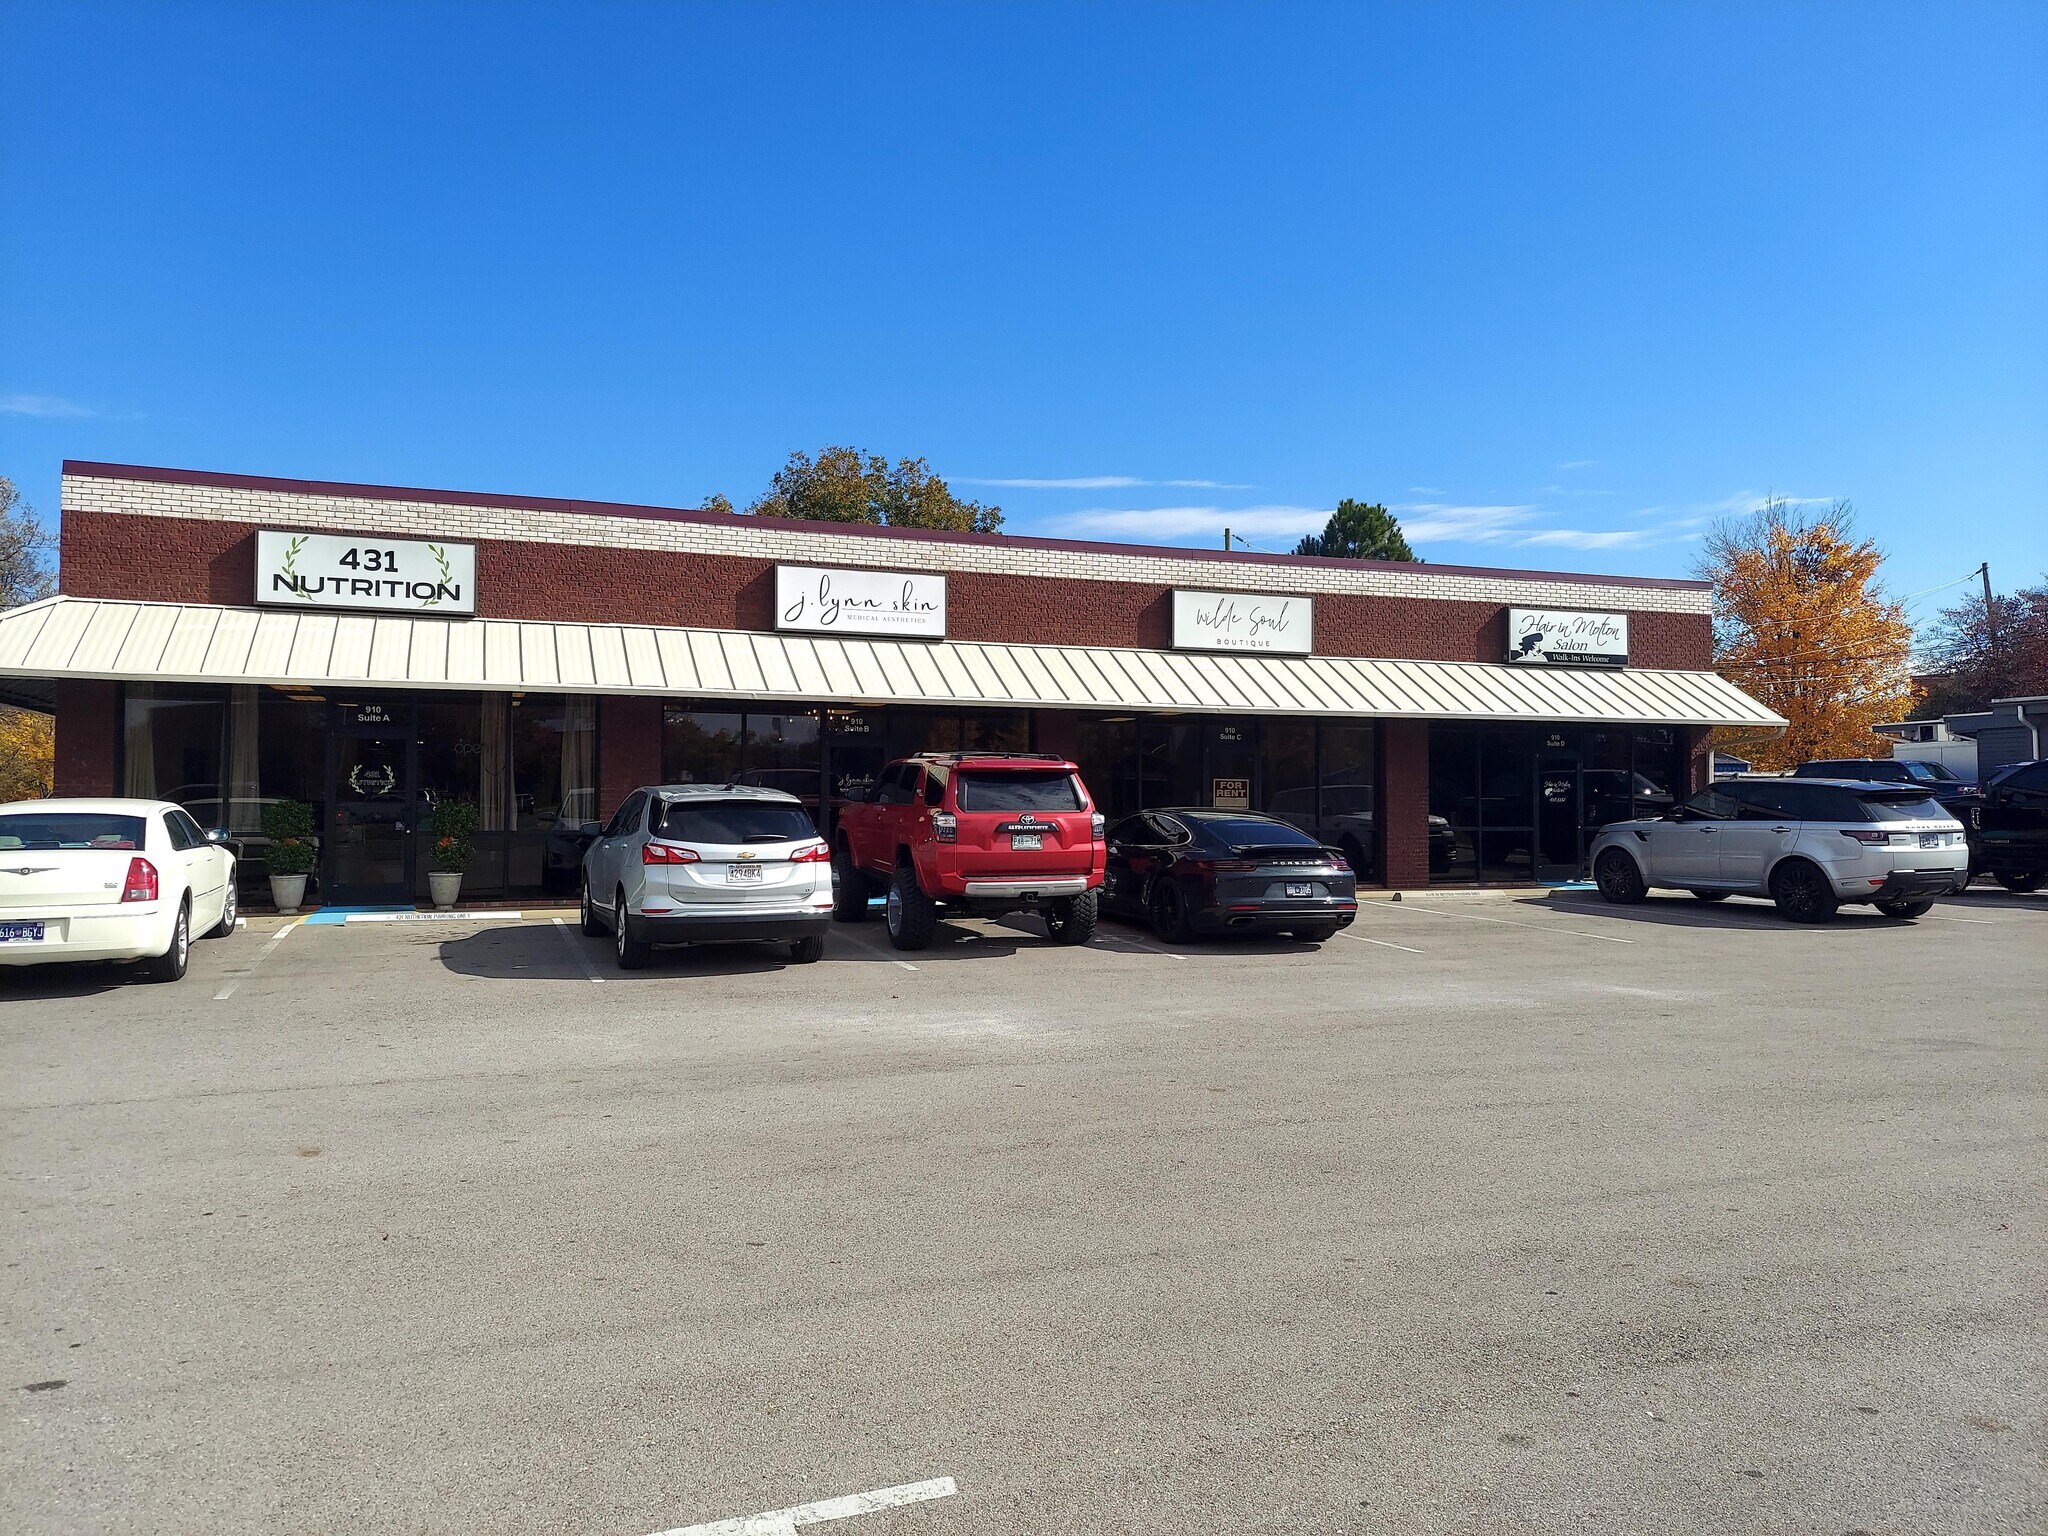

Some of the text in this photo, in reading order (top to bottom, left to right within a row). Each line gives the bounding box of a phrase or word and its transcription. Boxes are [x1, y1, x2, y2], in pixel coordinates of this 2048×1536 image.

[339, 548, 398, 572] 431
[272, 573, 461, 601] NUTRITION
[893, 580, 939, 611] skin
[883, 616, 926, 624] AESTHETICS
[1249, 601, 1290, 636] Soul
[1519, 615, 1620, 646] Hair in Motion
[1216, 638, 1271, 647] BOUTIQUE
[1553, 639, 1588, 651] Salon
[1552, 653, 1610, 663] Walk-Ins Welcome
[365, 706, 382, 714] 910
[357, 714, 390, 722] Suite A
[1219, 781, 1243, 790] FOR
[1216, 789, 1246, 797] RENT
[22, 926, 43, 937] BGYJ
